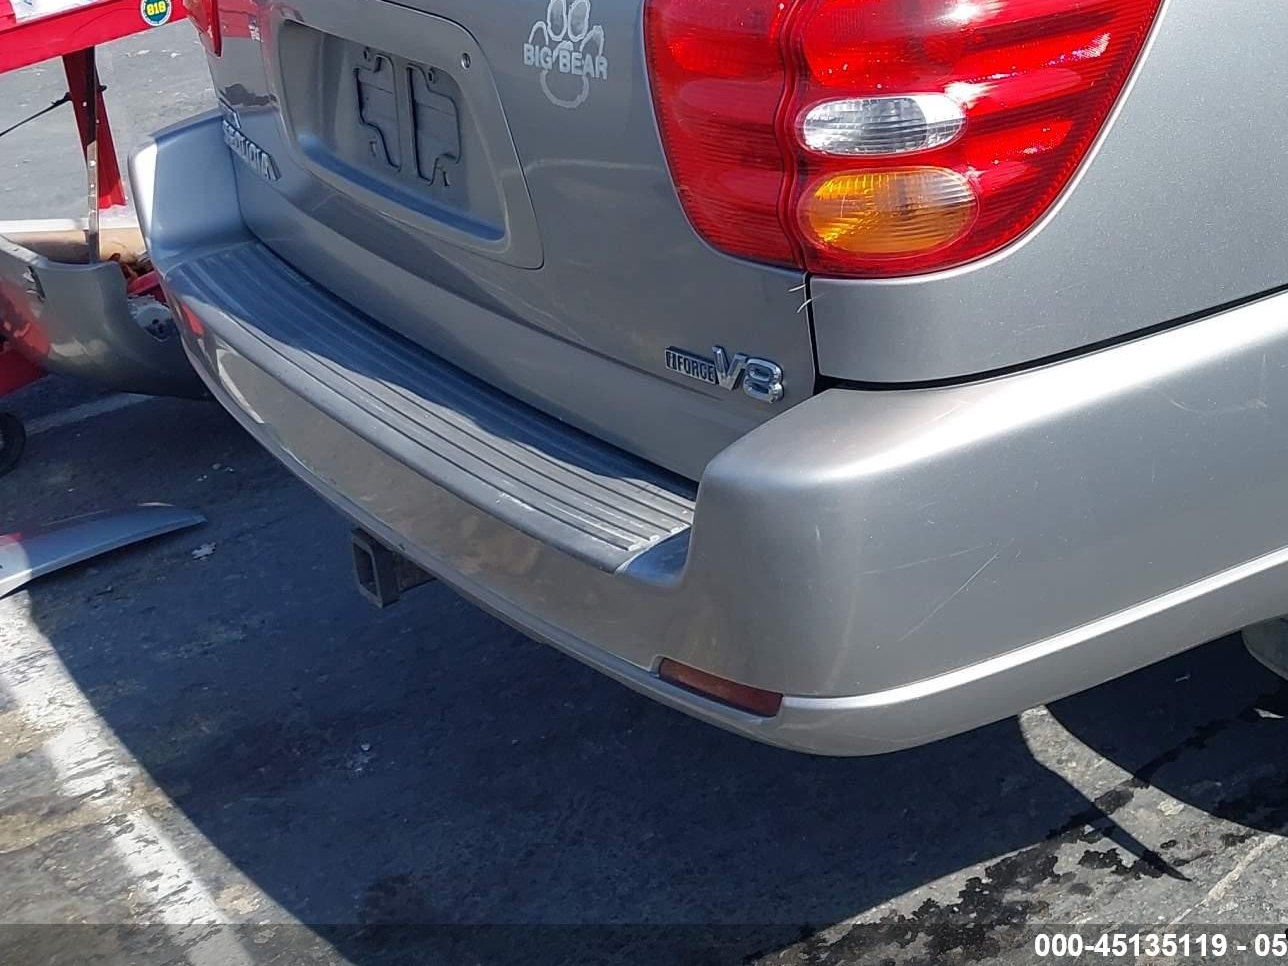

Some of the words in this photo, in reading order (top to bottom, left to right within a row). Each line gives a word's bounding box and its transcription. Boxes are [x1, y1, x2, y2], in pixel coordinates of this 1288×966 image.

[523, 43, 553, 70] BIG
[559, 49, 608, 80] BEAR
[712, 345, 784, 404] V8
